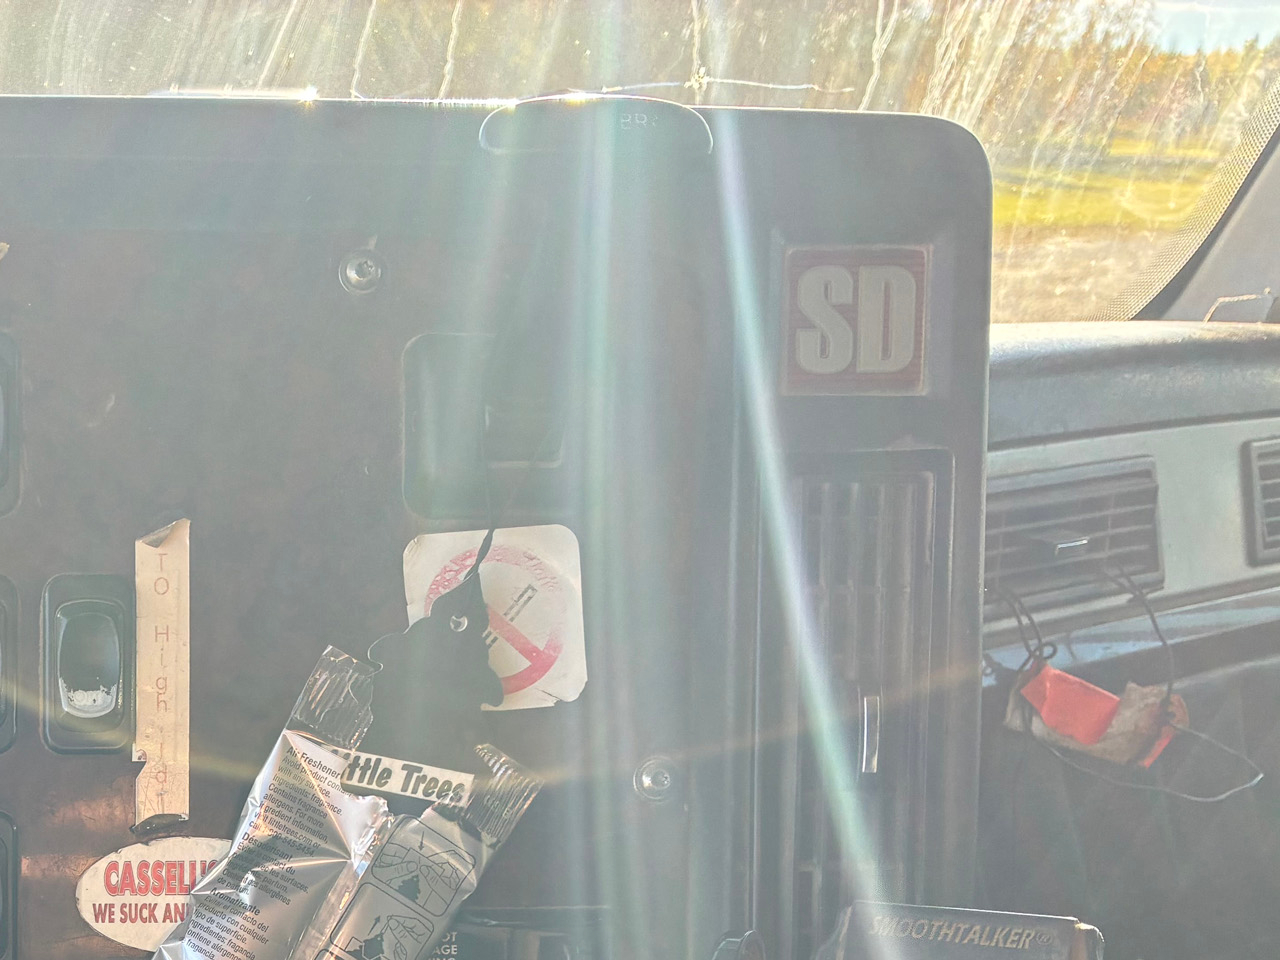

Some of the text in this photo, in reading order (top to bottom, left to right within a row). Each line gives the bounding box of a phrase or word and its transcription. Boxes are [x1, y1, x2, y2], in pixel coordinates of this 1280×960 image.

[795, 265, 917, 374] SD
[301, 752, 340, 778] Freshener
[401, 764, 464, 803] Trees
[268, 783, 328, 819] Contains fragrance
[294, 808, 306, 818] For
[307, 815, 324, 828] more
[93, 903, 115, 923] WE
[120, 903, 158, 924] SUCK
[210, 887, 261, 916] Aromatizante
[197, 903, 269, 945] producto con cualquier
[215, 921, 247, 945] superficie.
[230, 906, 269, 933] contacto del
[186, 939, 215, 960] fragancia.
[190, 919, 256, 960] ngredientes: fragancia.
